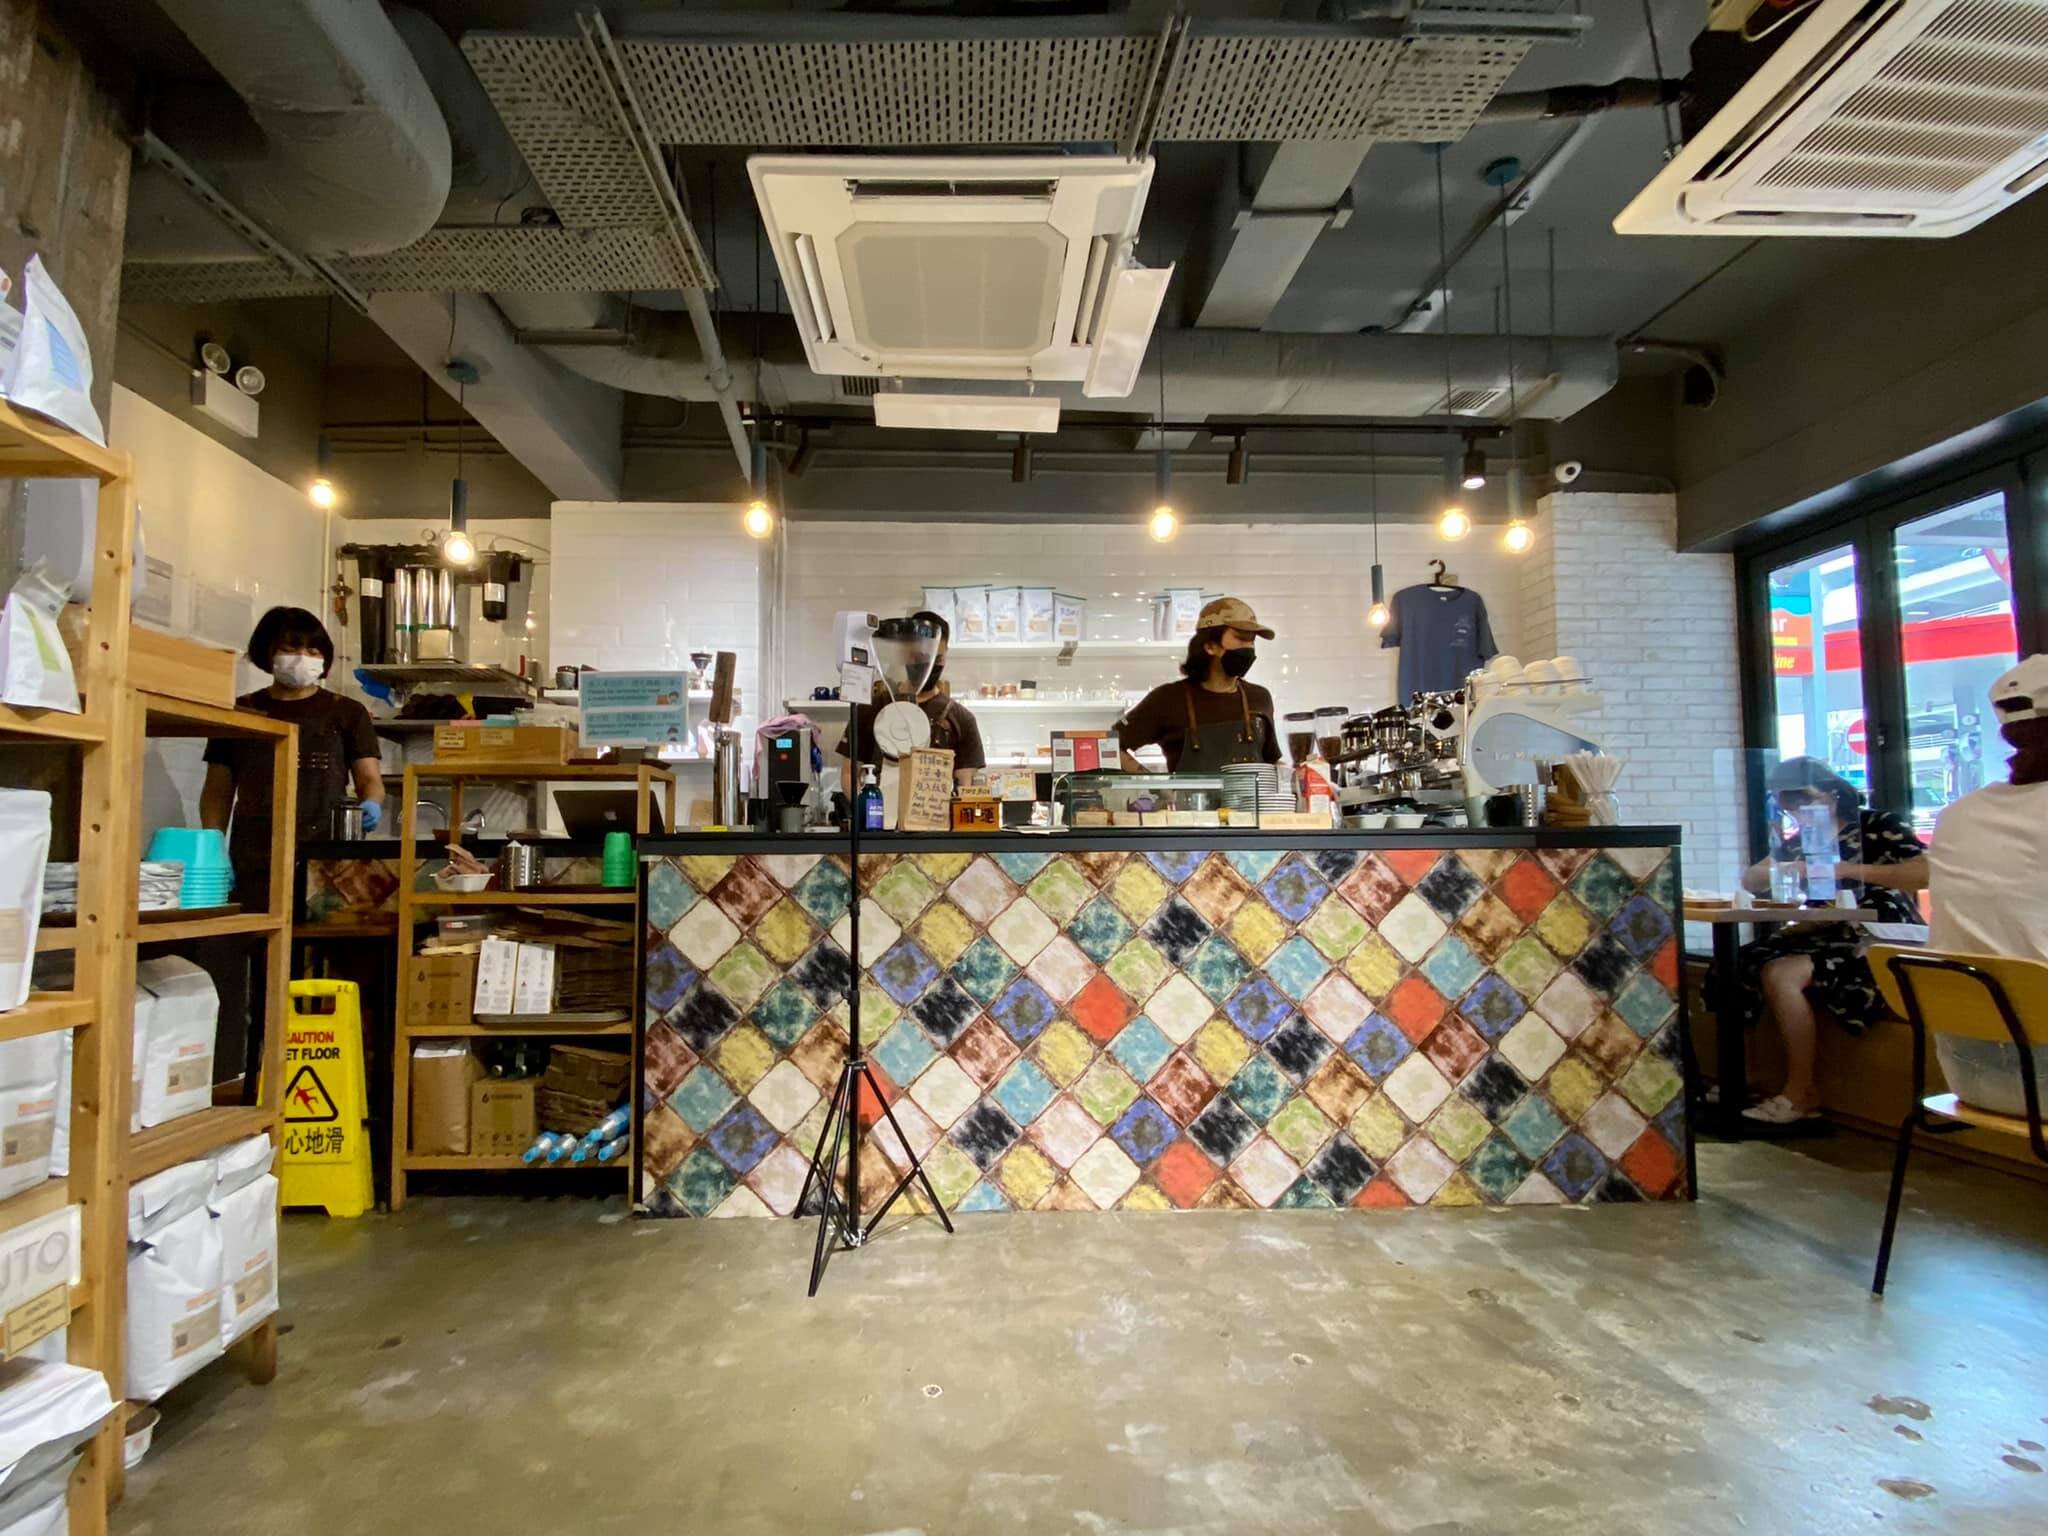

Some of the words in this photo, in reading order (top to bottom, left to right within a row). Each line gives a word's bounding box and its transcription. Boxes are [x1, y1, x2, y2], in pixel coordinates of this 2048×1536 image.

[288, 1031, 334, 1044] AUTION
[287, 1048, 299, 1060] ET
[301, 1047, 340, 1060] FLOOR
[284, 1127, 344, 1155] 心地滑
